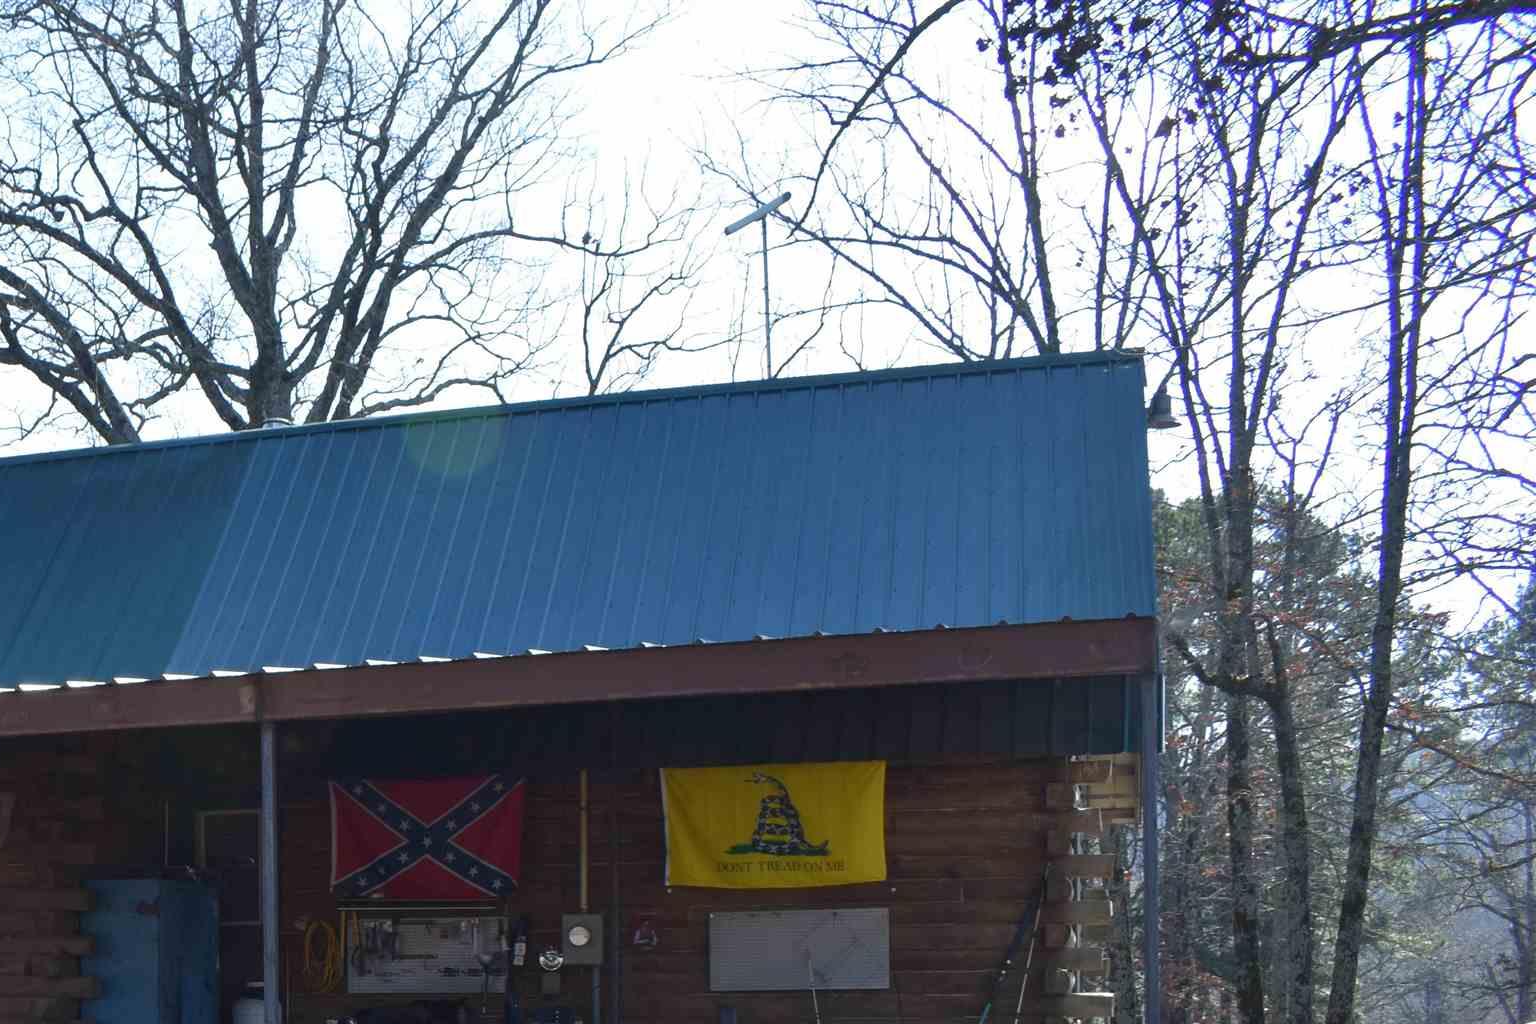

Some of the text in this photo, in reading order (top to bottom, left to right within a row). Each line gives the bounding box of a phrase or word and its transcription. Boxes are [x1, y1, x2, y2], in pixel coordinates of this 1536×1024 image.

[759, 861, 801, 872] TREAD
[803, 861, 823, 872] ON
[825, 860, 845, 872] ME
